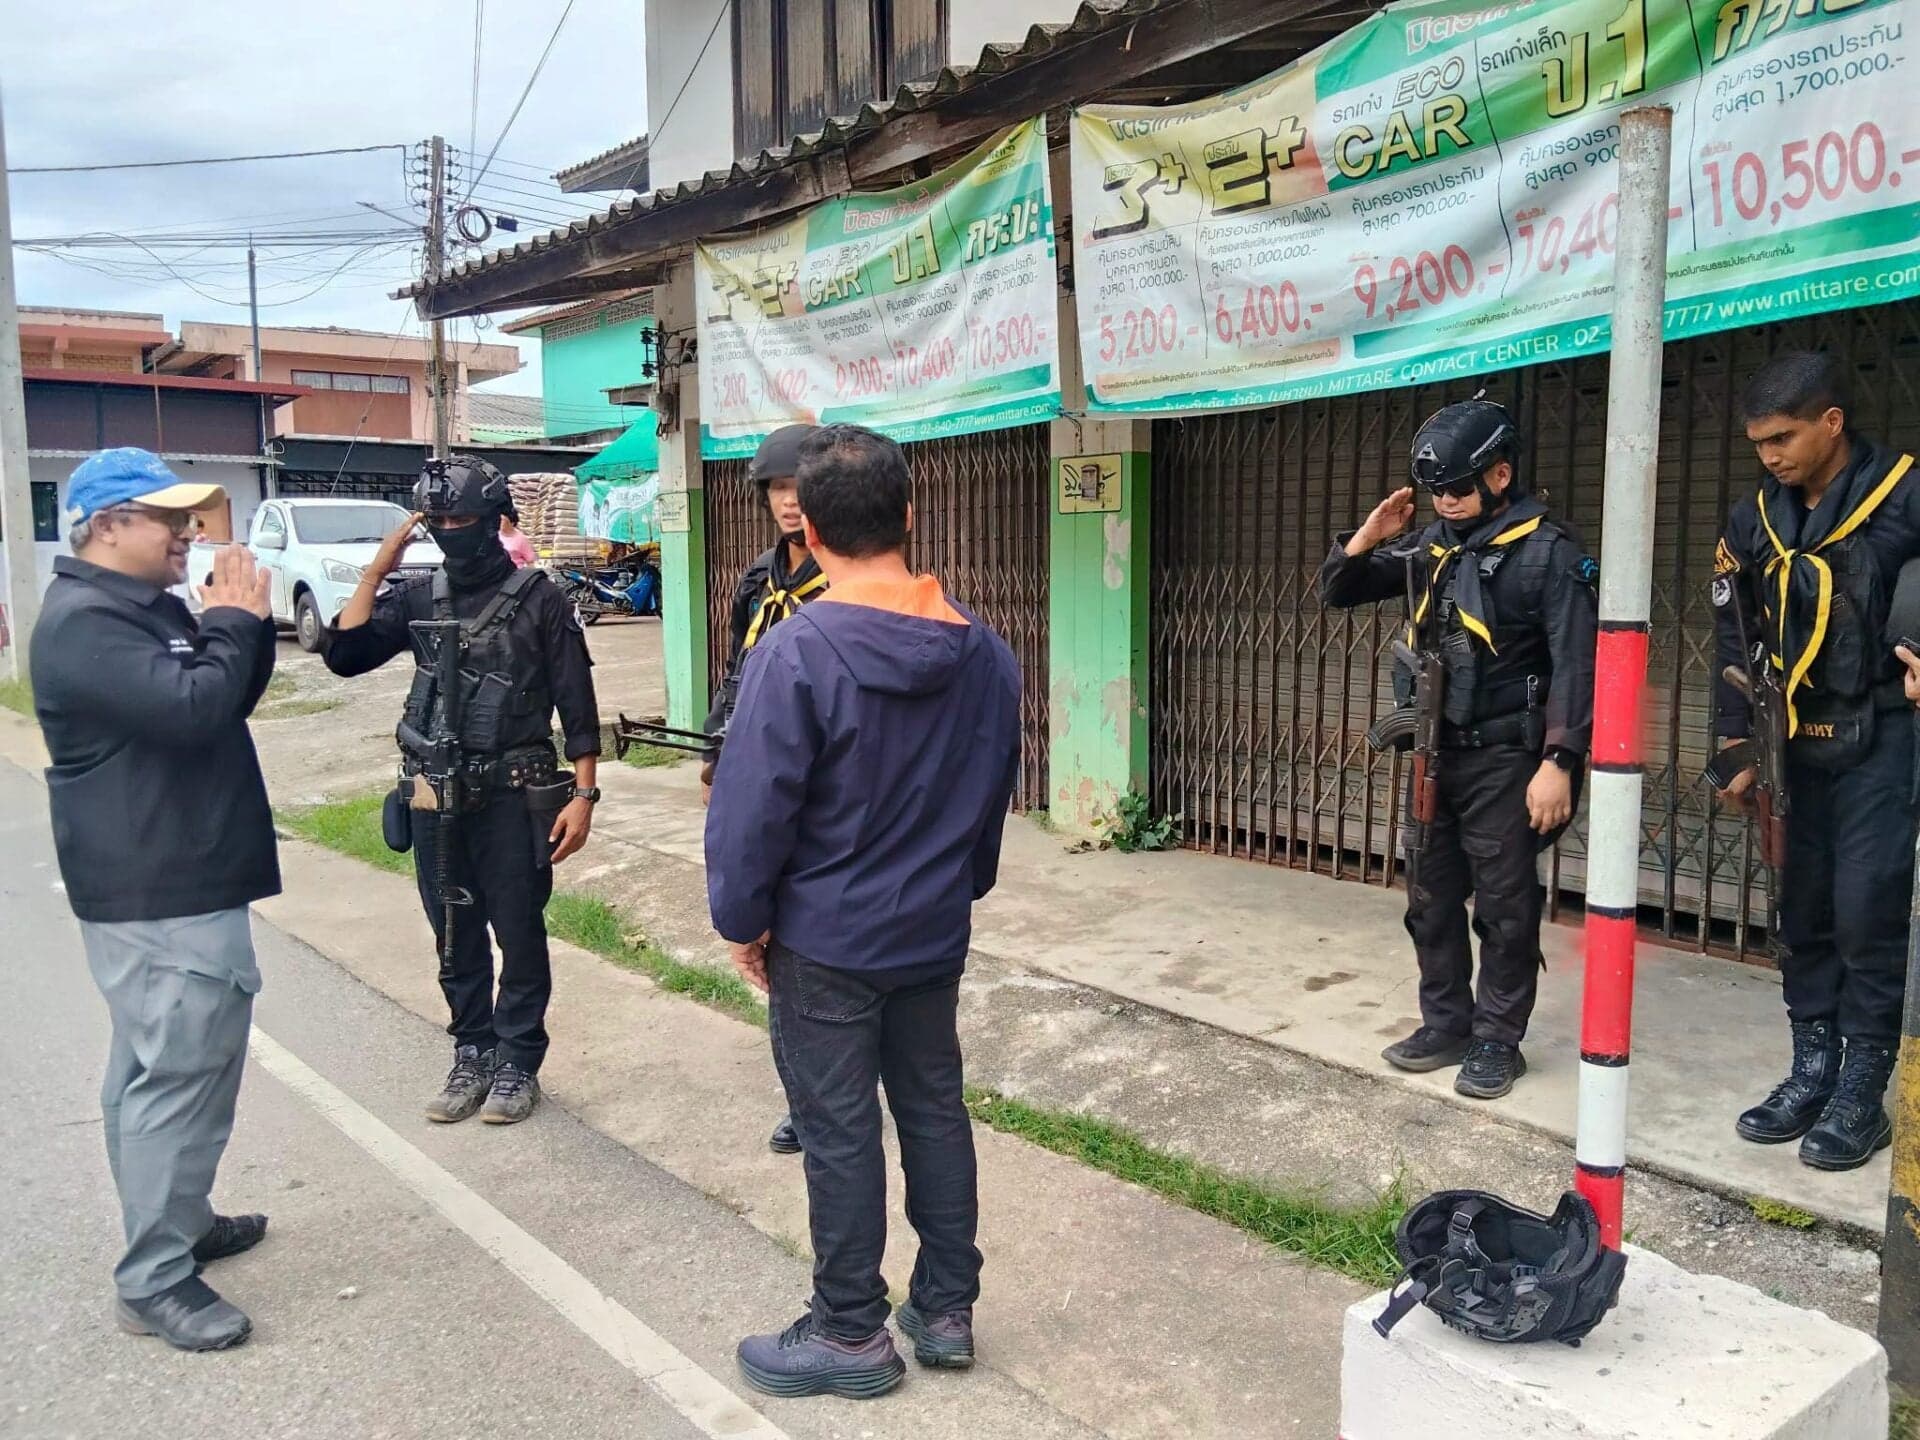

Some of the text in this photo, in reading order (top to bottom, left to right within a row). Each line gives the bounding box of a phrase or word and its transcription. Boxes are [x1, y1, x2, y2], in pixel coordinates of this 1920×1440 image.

[1481, 25, 1567, 73] รถเก๋งเล็ก
[1716, 22, 1903, 97] คุ้มครองรถประกัน
[1392, 56, 1465, 108] ECO
[1712, 89, 1764, 121] สูงสุด
[1333, 93, 1474, 180] CAR
[1352, 165, 1485, 217] คุ้มครองรถประกัน
[1525, 161, 1578, 190] สูงสุด
[1702, 121, 1920, 227] 10,500.-
[805, 262, 864, 306] CAR
[1353, 244, 1504, 322] 9,200.-
[972, 312, 1047, 370] 10,500.-
[1100, 304, 1199, 367] 5,200.-
[1215, 279, 1324, 349] 6,400.-
[1329, 366, 1393, 394] MITTARE
[1401, 350, 1481, 383] CONTACT
[1485, 334, 1558, 364] CENTER
[1718, 263, 1920, 318] www.mittare.com
